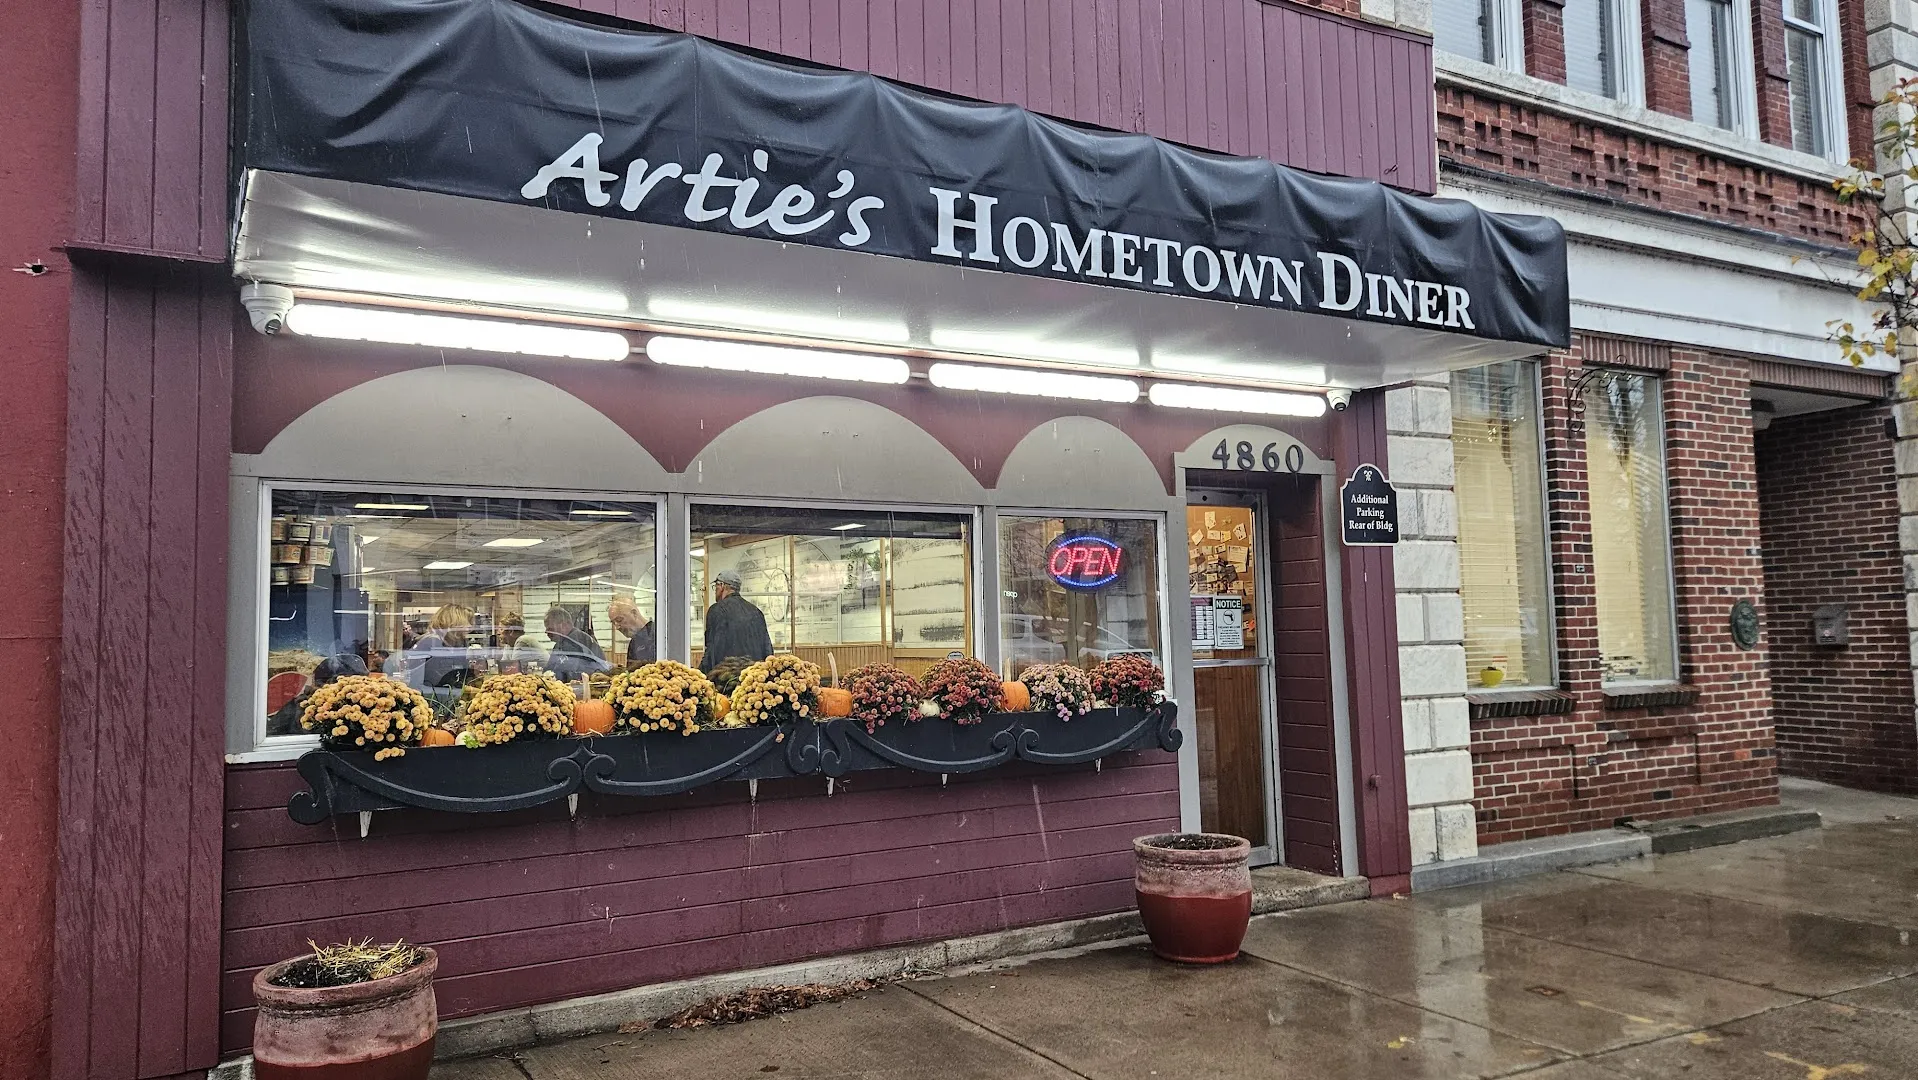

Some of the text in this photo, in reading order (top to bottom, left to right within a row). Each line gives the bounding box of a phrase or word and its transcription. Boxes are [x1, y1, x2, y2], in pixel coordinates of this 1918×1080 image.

[520, 132, 1476, 330] Artie's HOMETOWN DINER
[1212, 439, 1304, 473] 4860
[1351, 494, 1389, 504] Additional
[1356, 507, 1385, 519] Parking
[1349, 520, 1394, 532] Rear of Bldg
[1050, 547, 1122, 576] OPEN
[1216, 600, 1241, 609] NOTICE
